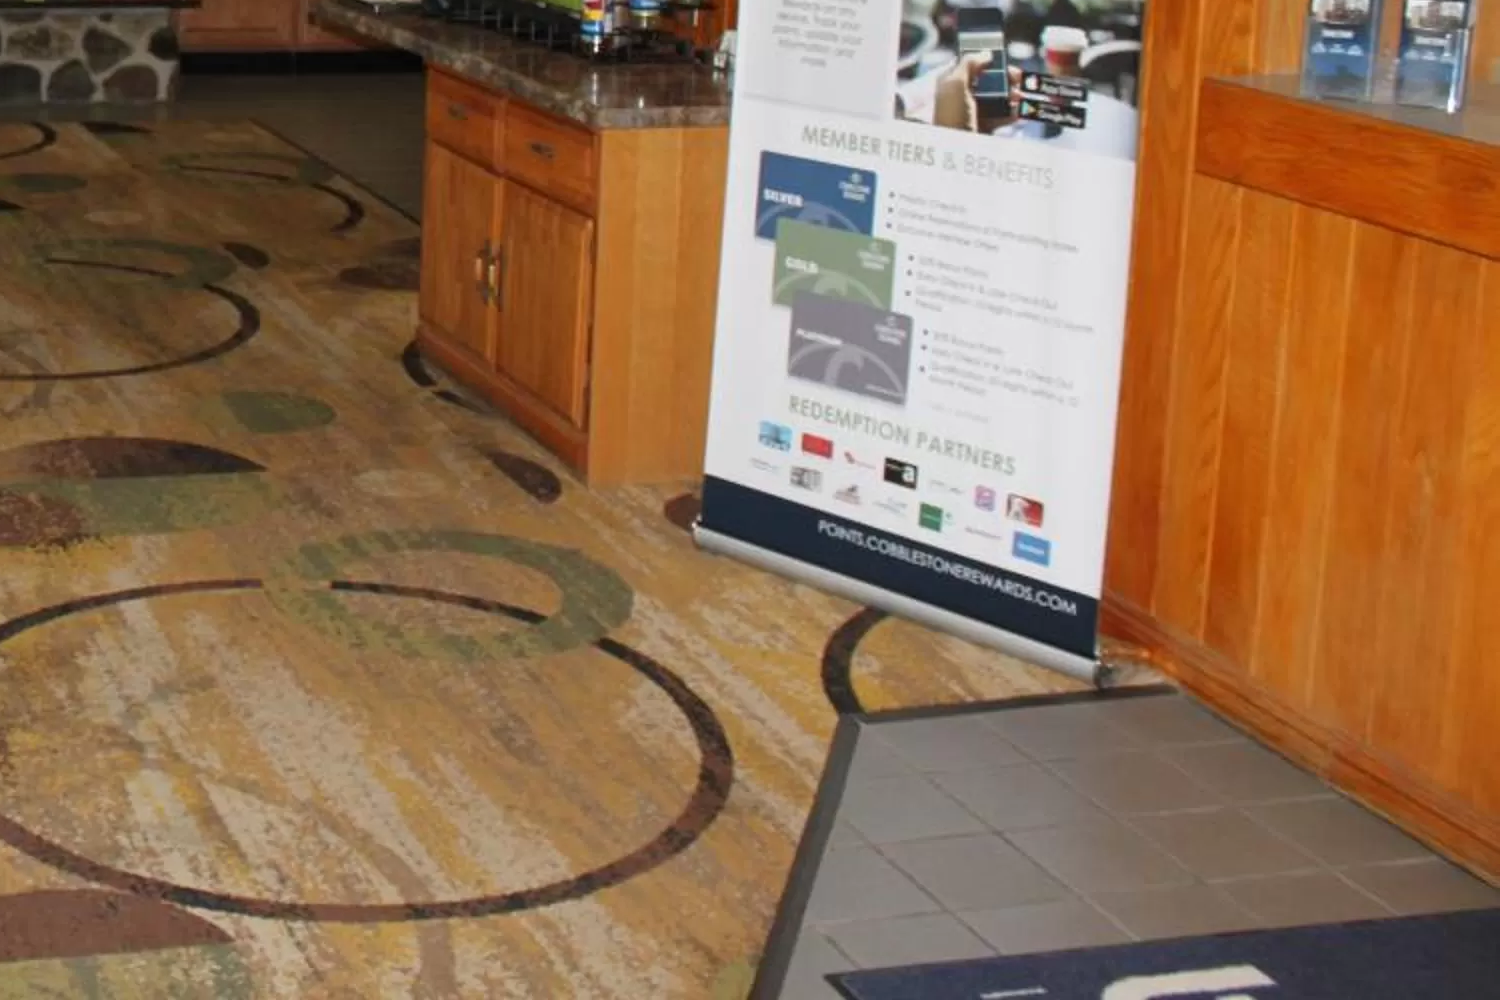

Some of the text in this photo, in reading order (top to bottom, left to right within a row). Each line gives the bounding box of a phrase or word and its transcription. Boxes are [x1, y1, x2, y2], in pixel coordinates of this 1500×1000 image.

[801, 125, 1056, 189] MEMBER TIERS & BENEFITS
[789, 395, 1016, 477] REDEMPTION PARTNERS
[817, 519, 1078, 617] POINTS.COBBLESTONEREWARDS.COM
